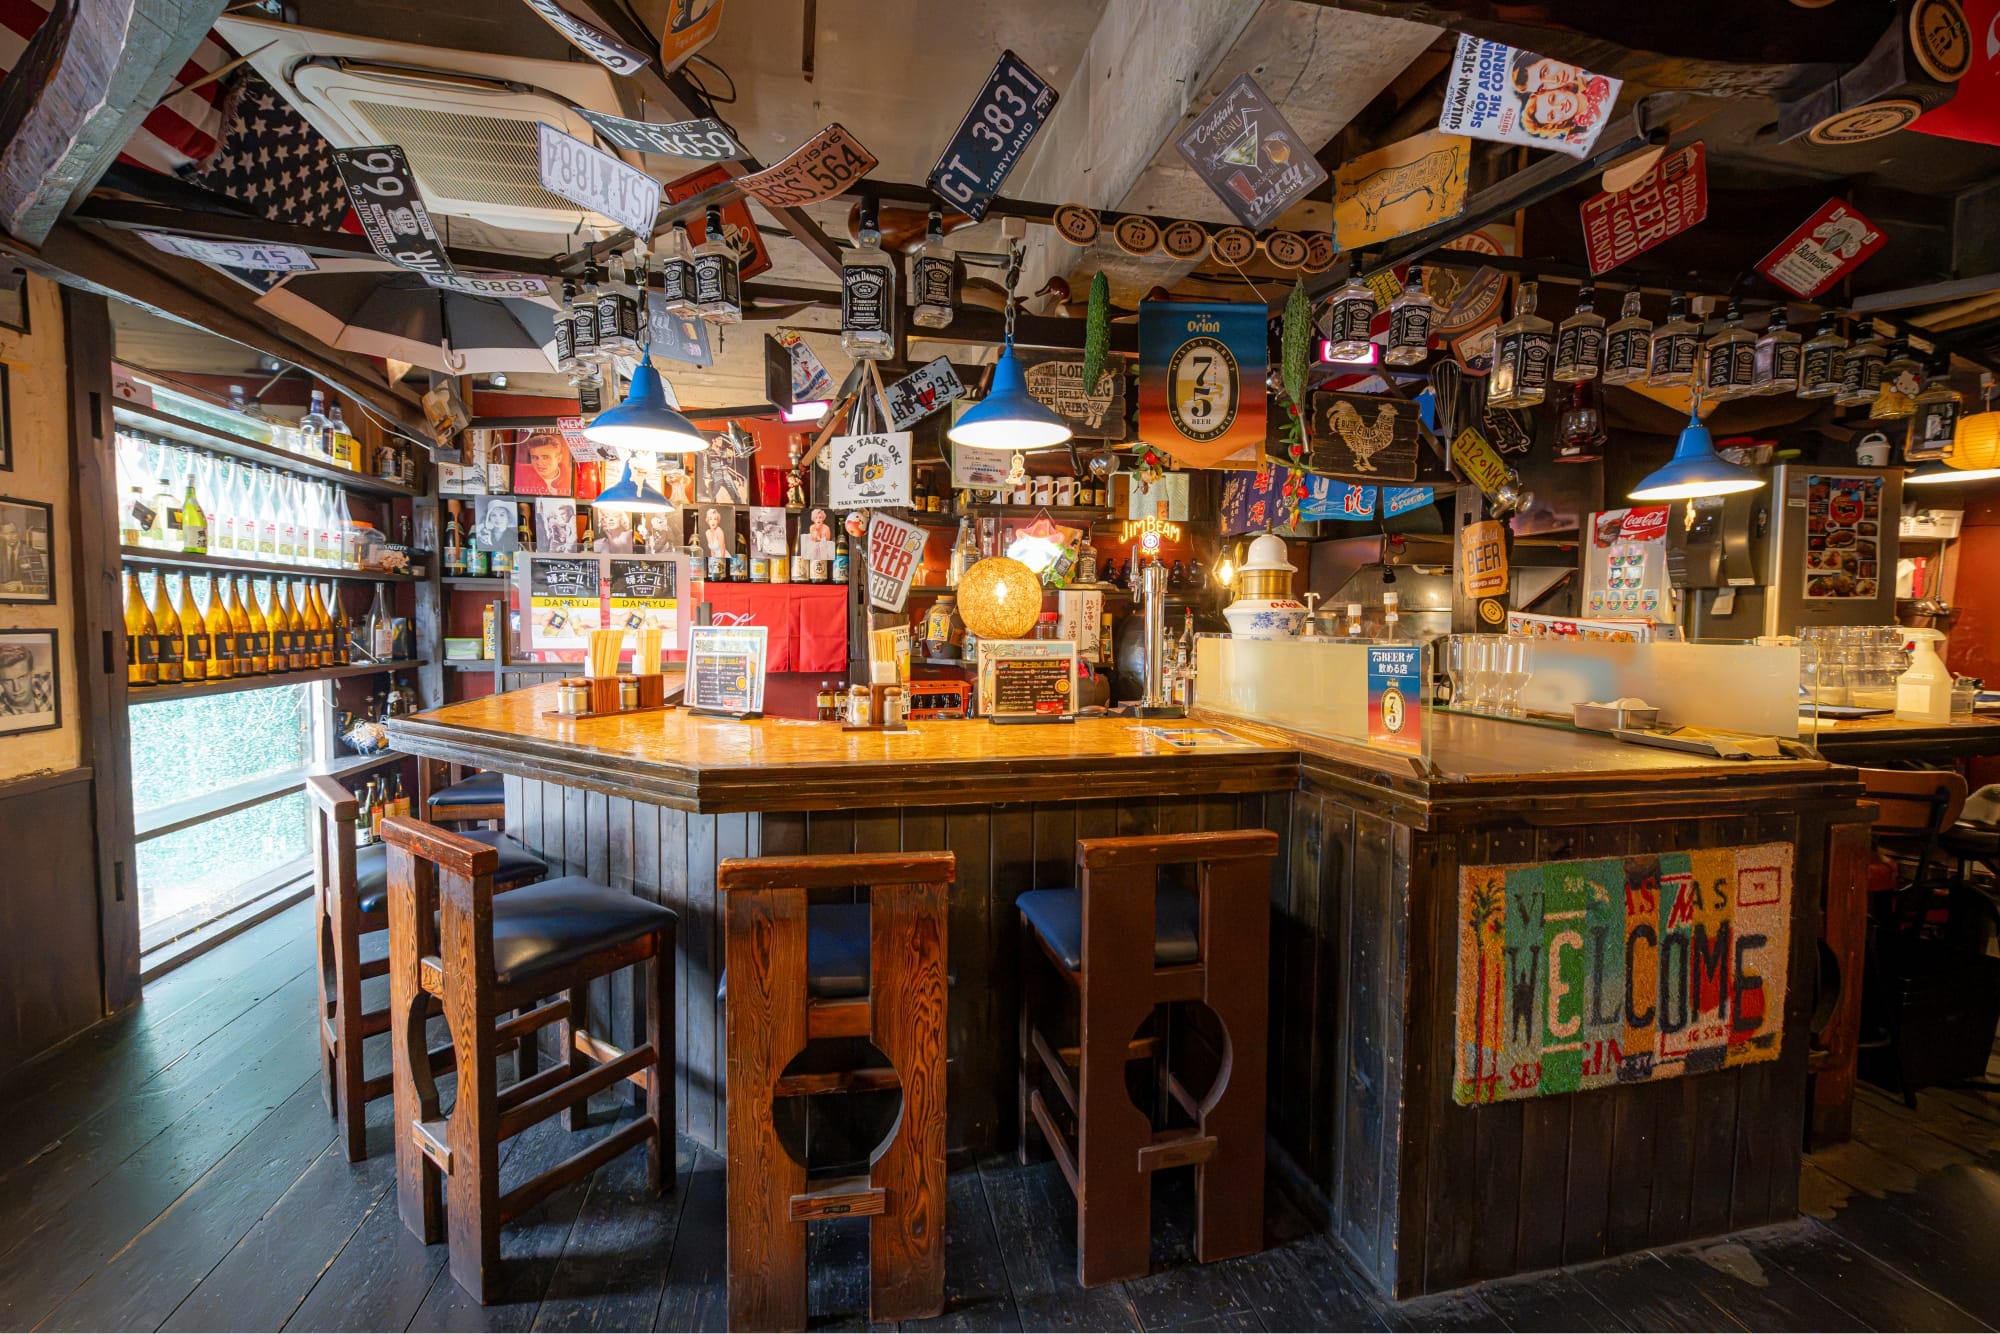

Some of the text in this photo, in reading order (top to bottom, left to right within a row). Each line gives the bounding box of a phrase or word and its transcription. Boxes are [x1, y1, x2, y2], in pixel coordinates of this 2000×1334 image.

[1470, 40, 1495, 128] SHOP AROUN
[1487, 45, 1508, 118] THE CORNE
[941, 67, 1038, 203] GT 3831
[1196, 99, 1235, 143] Cocktail
[1212, 114, 1243, 146] MENU
[742, 131, 842, 188] DOWNEY-1946
[987, 122, 1033, 190] MARYLAND
[352, 152, 404, 197] 66
[617, 167, 657, 237] USA
[1629, 166, 1665, 250] BEER
[1664, 184, 1681, 235] GOOD
[1682, 174, 1698, 215] DRINK
[356, 198, 375, 226] ROUTE
[416, 207, 431, 233] ROUTE
[1587, 192, 1618, 272] FRIENDS
[1614, 207, 1638, 260] GOOD
[1795, 243, 1833, 273] Budweiser
[846, 272, 860, 286] JACK
[1187, 319, 1220, 333] Orion
[1059, 365, 1083, 377] LOI
[917, 371, 959, 404] 1234
[1058, 390, 1084, 399] BELLY
[1096, 379, 1110, 397] EG
[839, 444, 856, 468] ONE
[857, 436, 888, 447] TAKE
[1456, 433, 1483, 464] 512
[873, 519, 908, 547] COLD
[1120, 515, 1180, 543] JIM BEAM
[1624, 510, 1666, 528] Coca-Cola
[869, 540, 913, 581] BEER
[1467, 542, 1502, 576] BEER
[544, 599, 589, 608] DANRYU
[622, 600, 666, 608] DANRYU
[1379, 663, 1407, 674] 飲める店
[1505, 920, 1768, 1047] WELCOME
